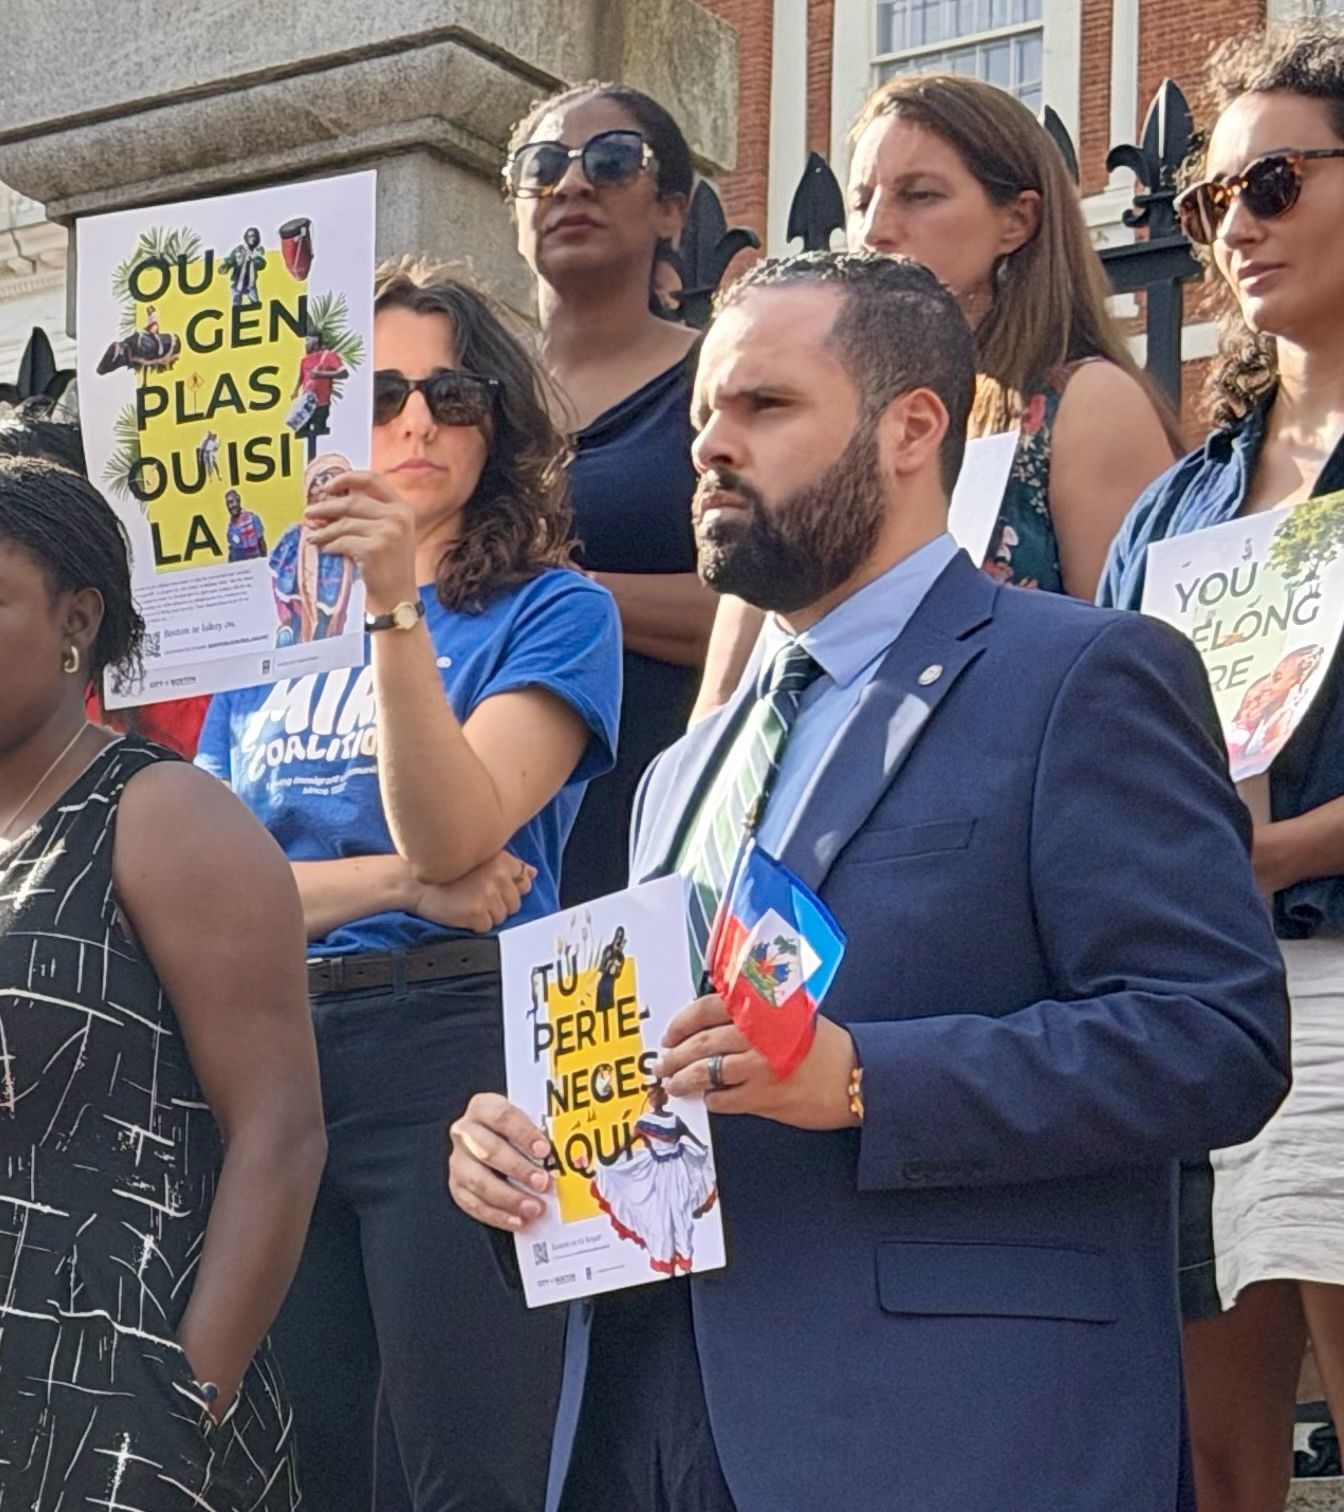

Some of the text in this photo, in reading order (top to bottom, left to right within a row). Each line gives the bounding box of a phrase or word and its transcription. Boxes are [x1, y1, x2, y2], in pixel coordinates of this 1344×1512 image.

[127, 248, 214, 303] OU
[186, 295, 309, 354] GEN
[136, 365, 281, 431] PLAS
[128, 448, 208, 502] OU
[149, 514, 223, 567] LA
[1175, 561, 1258, 614] YOU
[1192, 587, 1322, 653] ELONG
[1209, 655, 1255, 691] RE
[247, 726, 378, 783] COALITIO
[545, 1051, 663, 1118] NECES
